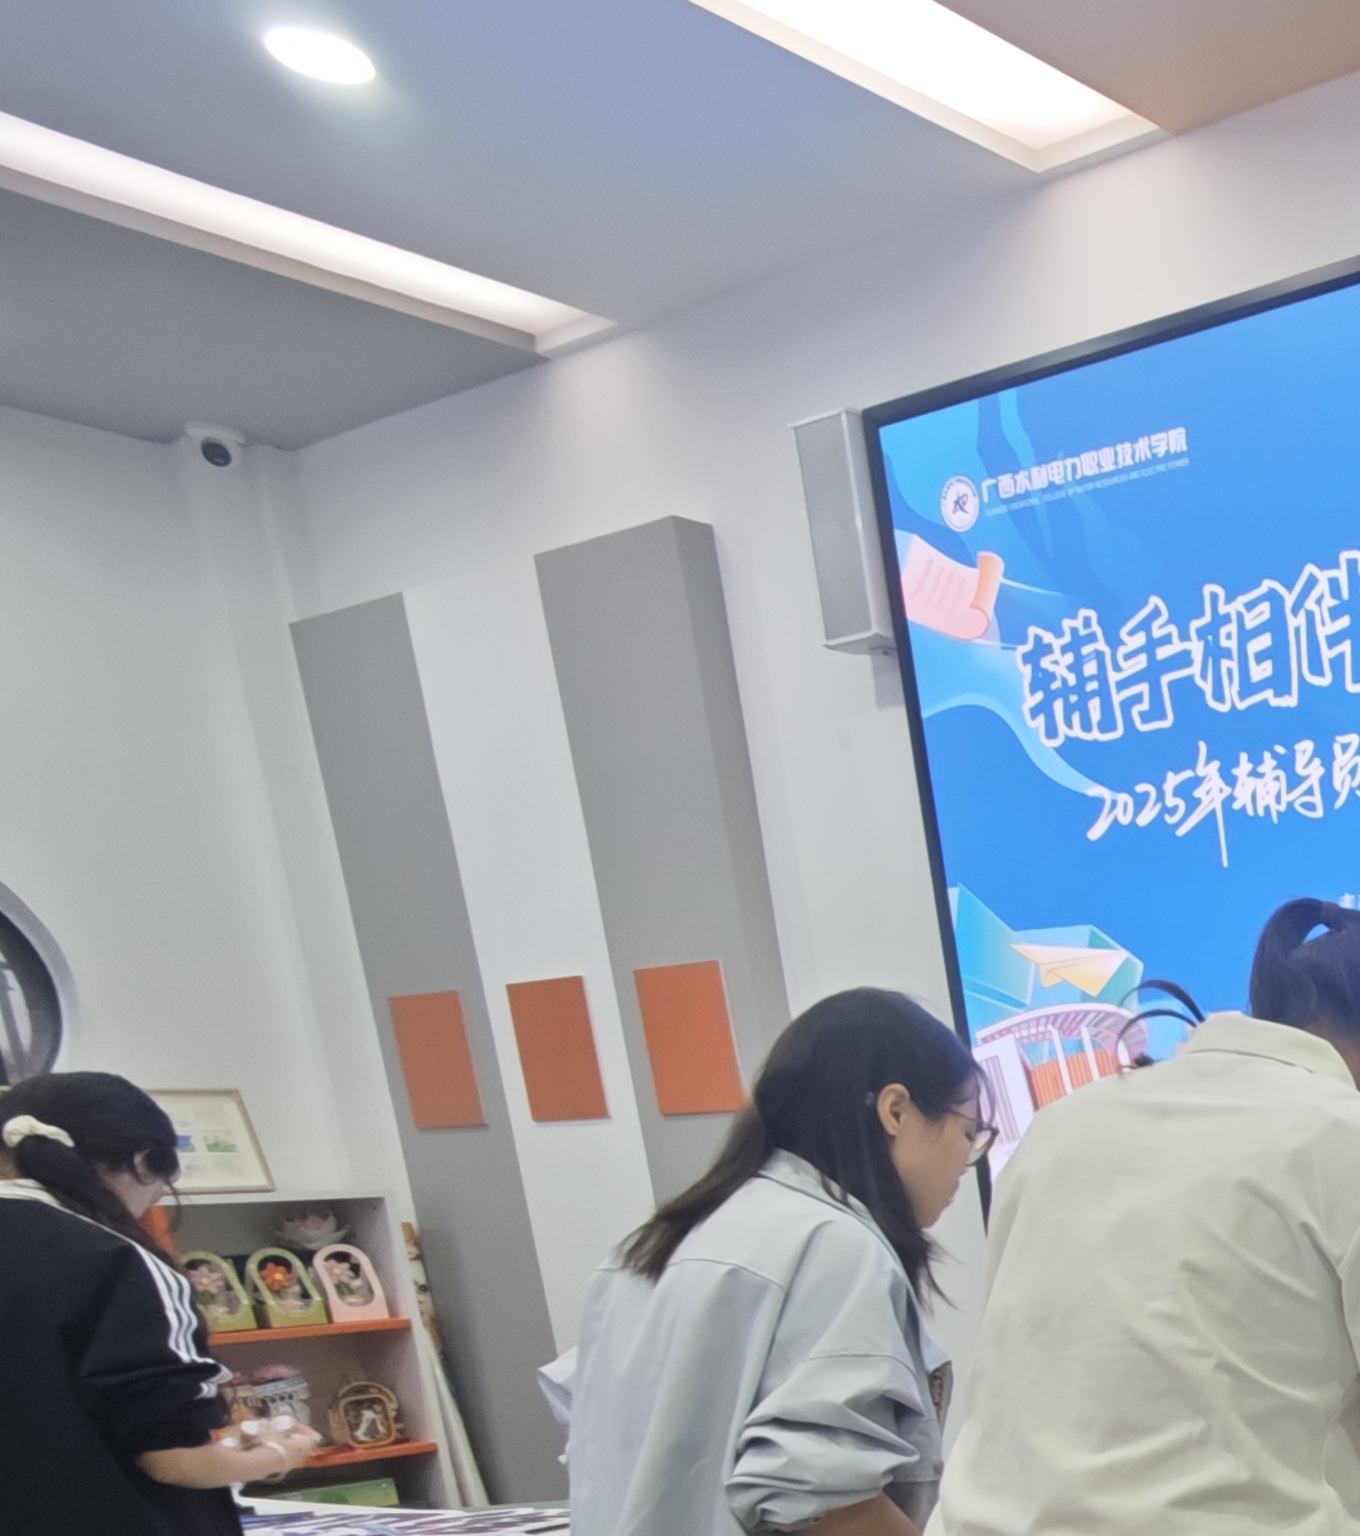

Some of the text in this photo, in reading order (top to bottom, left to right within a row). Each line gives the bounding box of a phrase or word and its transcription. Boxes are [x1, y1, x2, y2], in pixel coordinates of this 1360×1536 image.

[980, 426, 1189, 504] 广西水利电力职业技术学院
